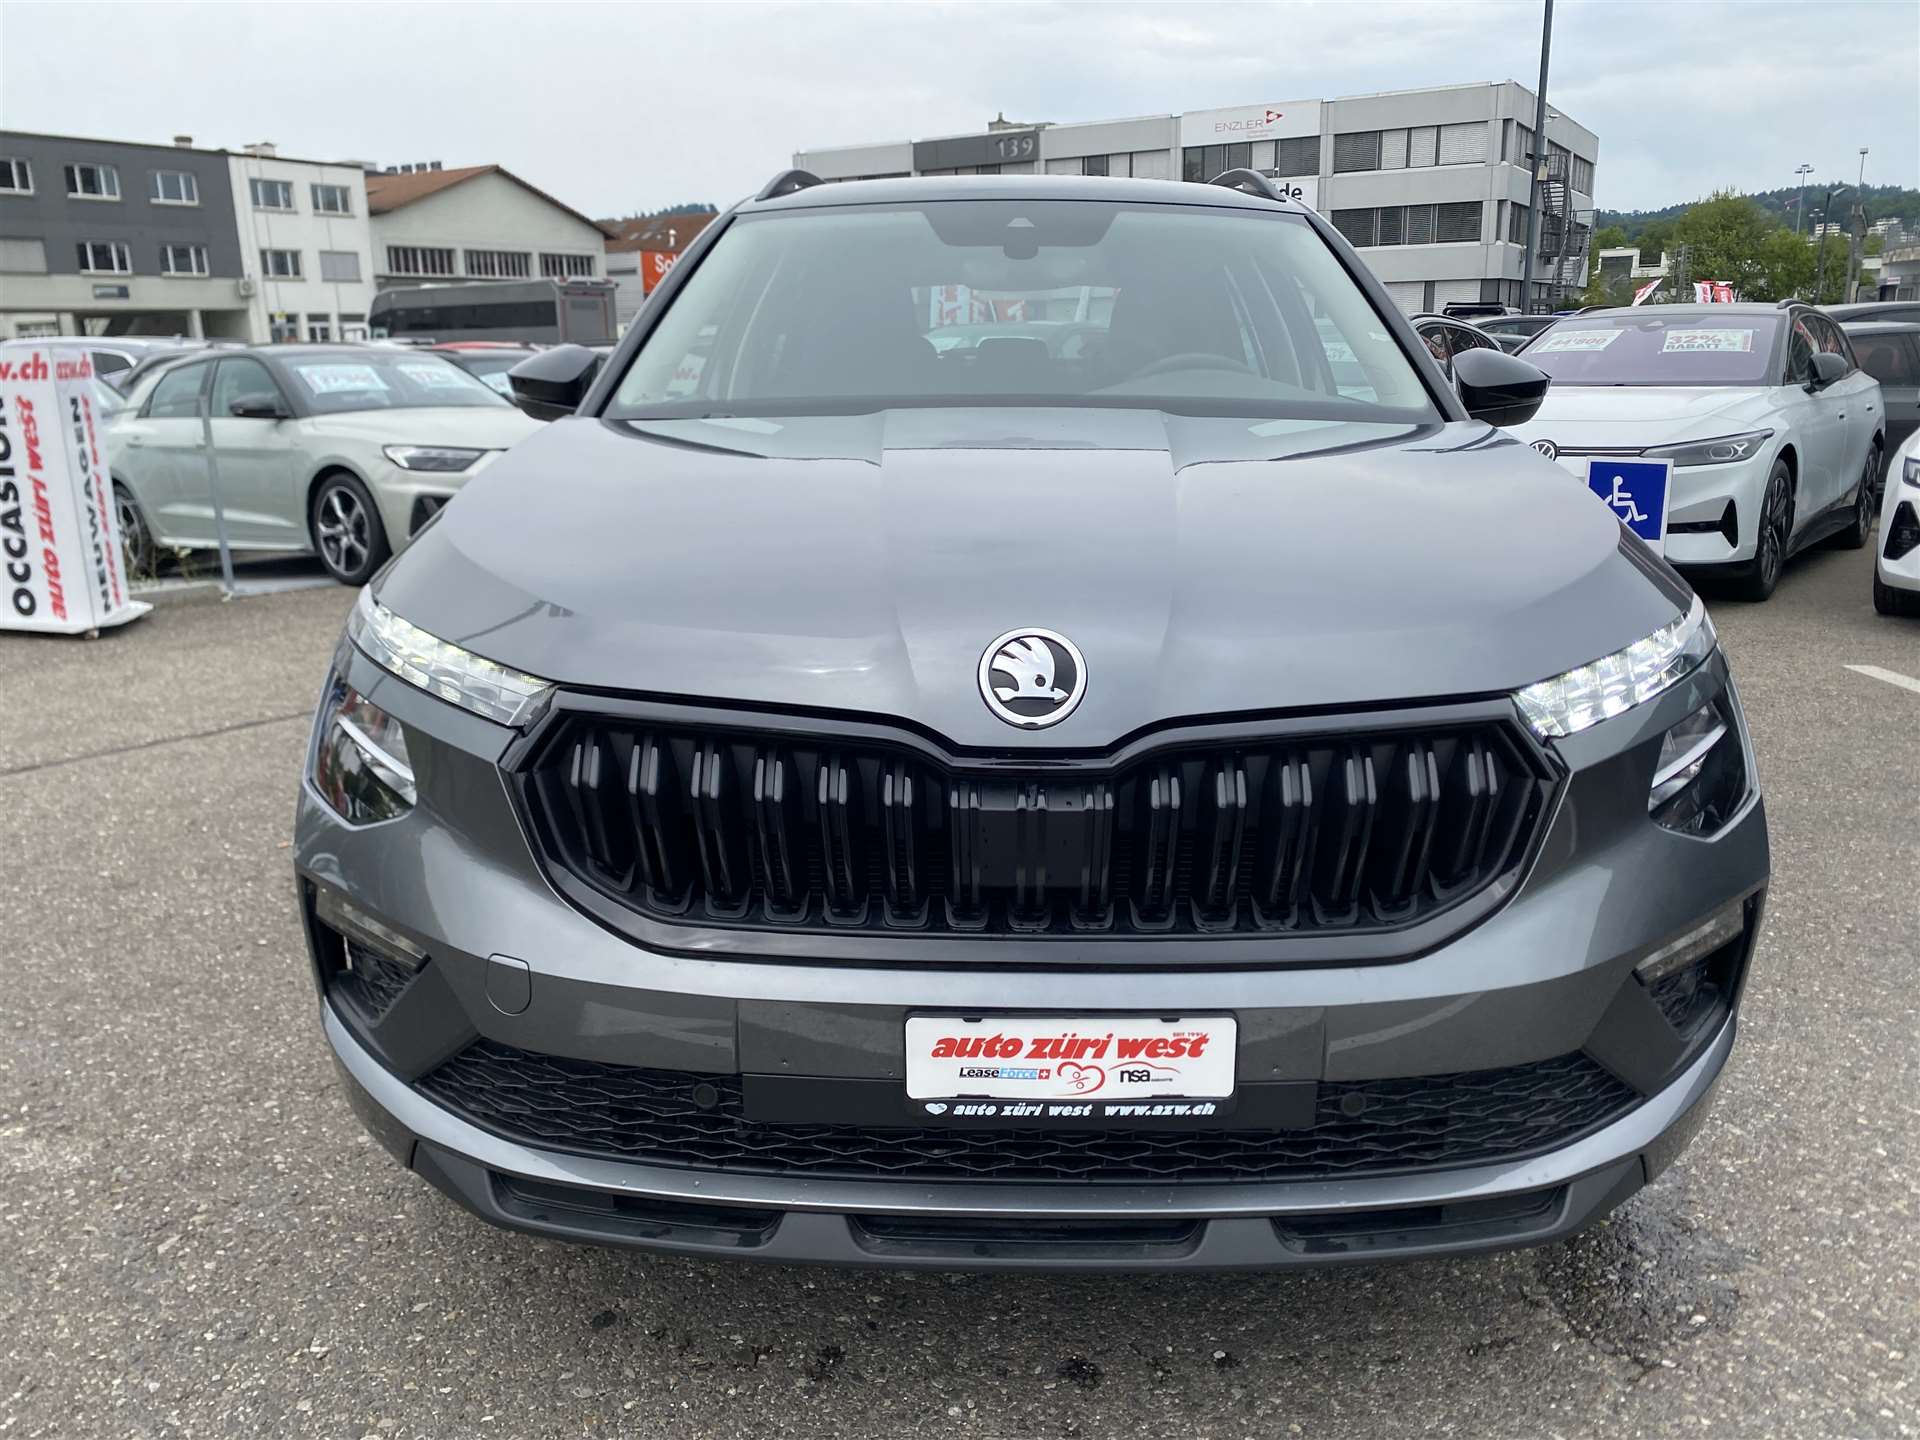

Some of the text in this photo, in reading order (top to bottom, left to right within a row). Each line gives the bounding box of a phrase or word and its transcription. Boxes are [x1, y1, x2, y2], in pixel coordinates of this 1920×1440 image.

[1215, 119, 1264, 132] ENZLER
[996, 138, 1033, 157] 139
[1668, 334, 1722, 345] 32%
[16, 394, 67, 621] auto züri west
[70, 396, 111, 614] NEUWAGEN
[931, 1032, 1210, 1059] auto züri west
[959, 1066, 1038, 1080] LeaseForce
[1119, 1069, 1151, 1083] nsa
[953, 1102, 1216, 1117] auto züri west www.azw.ch
